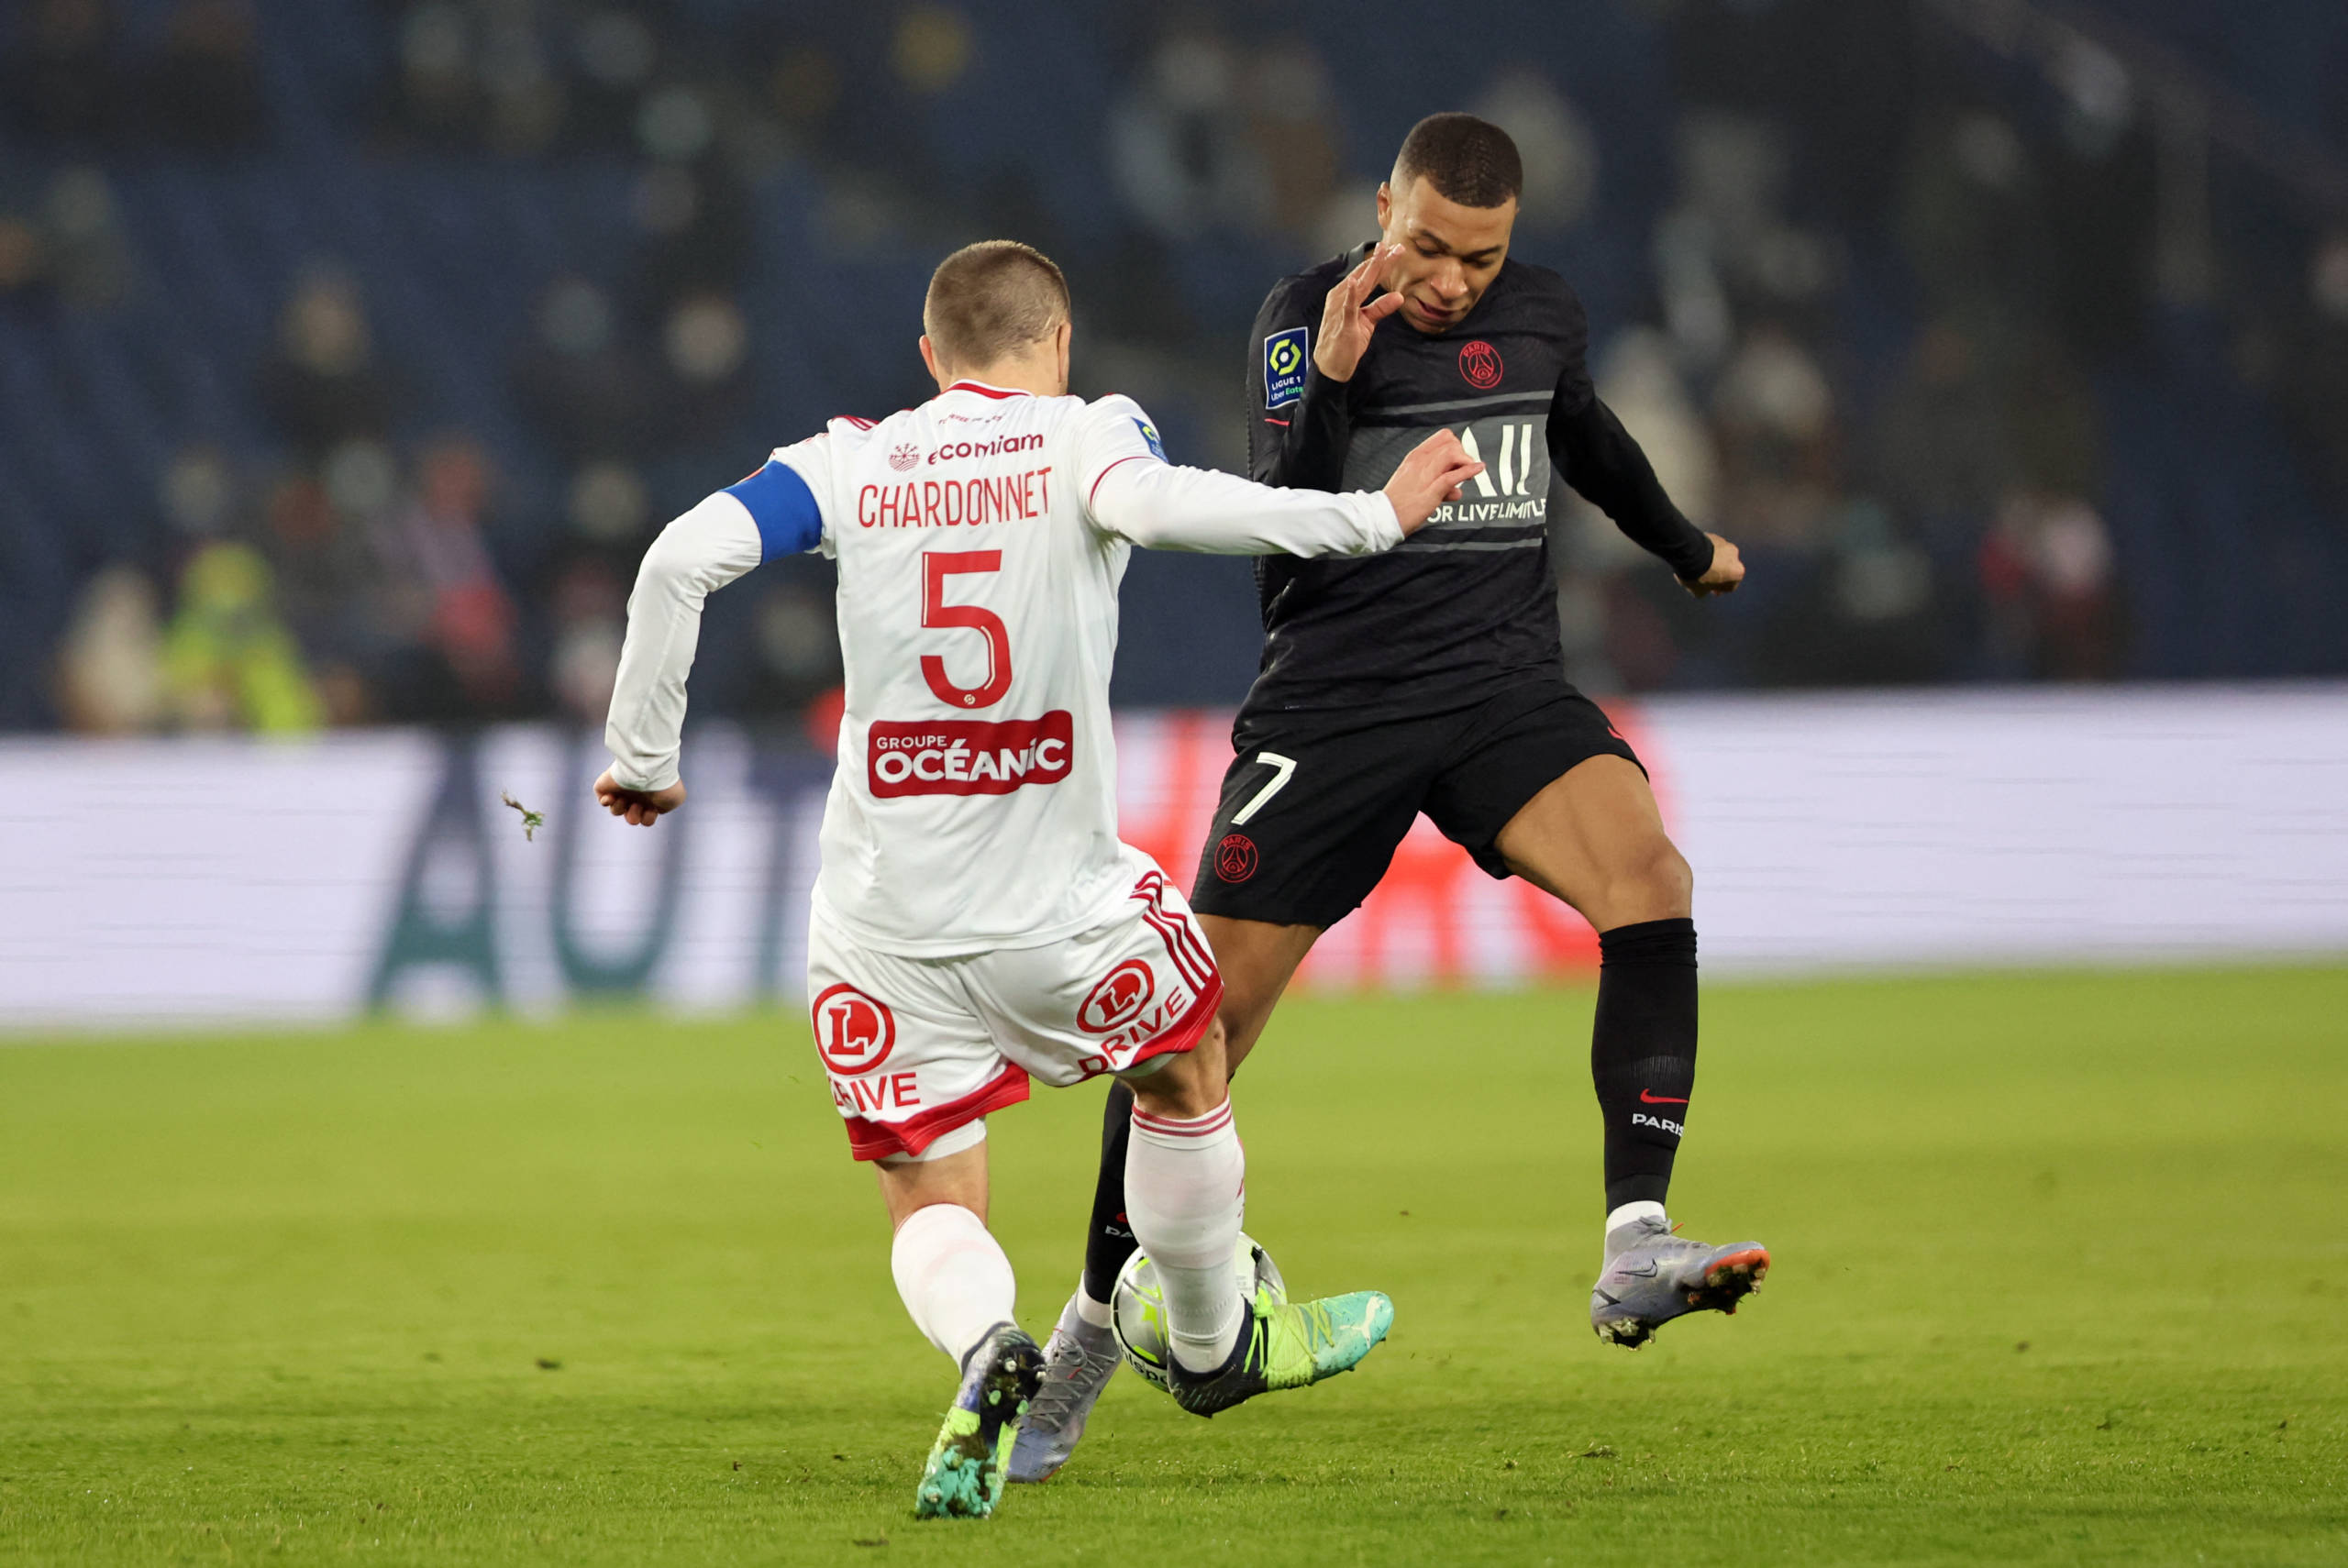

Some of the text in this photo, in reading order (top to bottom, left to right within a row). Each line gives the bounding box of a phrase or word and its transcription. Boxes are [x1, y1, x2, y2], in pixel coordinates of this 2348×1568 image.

[1271, 375, 1301, 391] LIGUE 1
[927, 434, 1044, 465] ecomiam
[858, 466, 1052, 528] CHARDONNET
[1426, 504, 1454, 524] OR
[920, 549, 1013, 710] 5
[876, 735, 947, 749] GROUPE
[1230, 752, 1298, 825] 7
[1222, 835, 1251, 852] PARIS
[1078, 985, 1187, 1075] DRIVE
